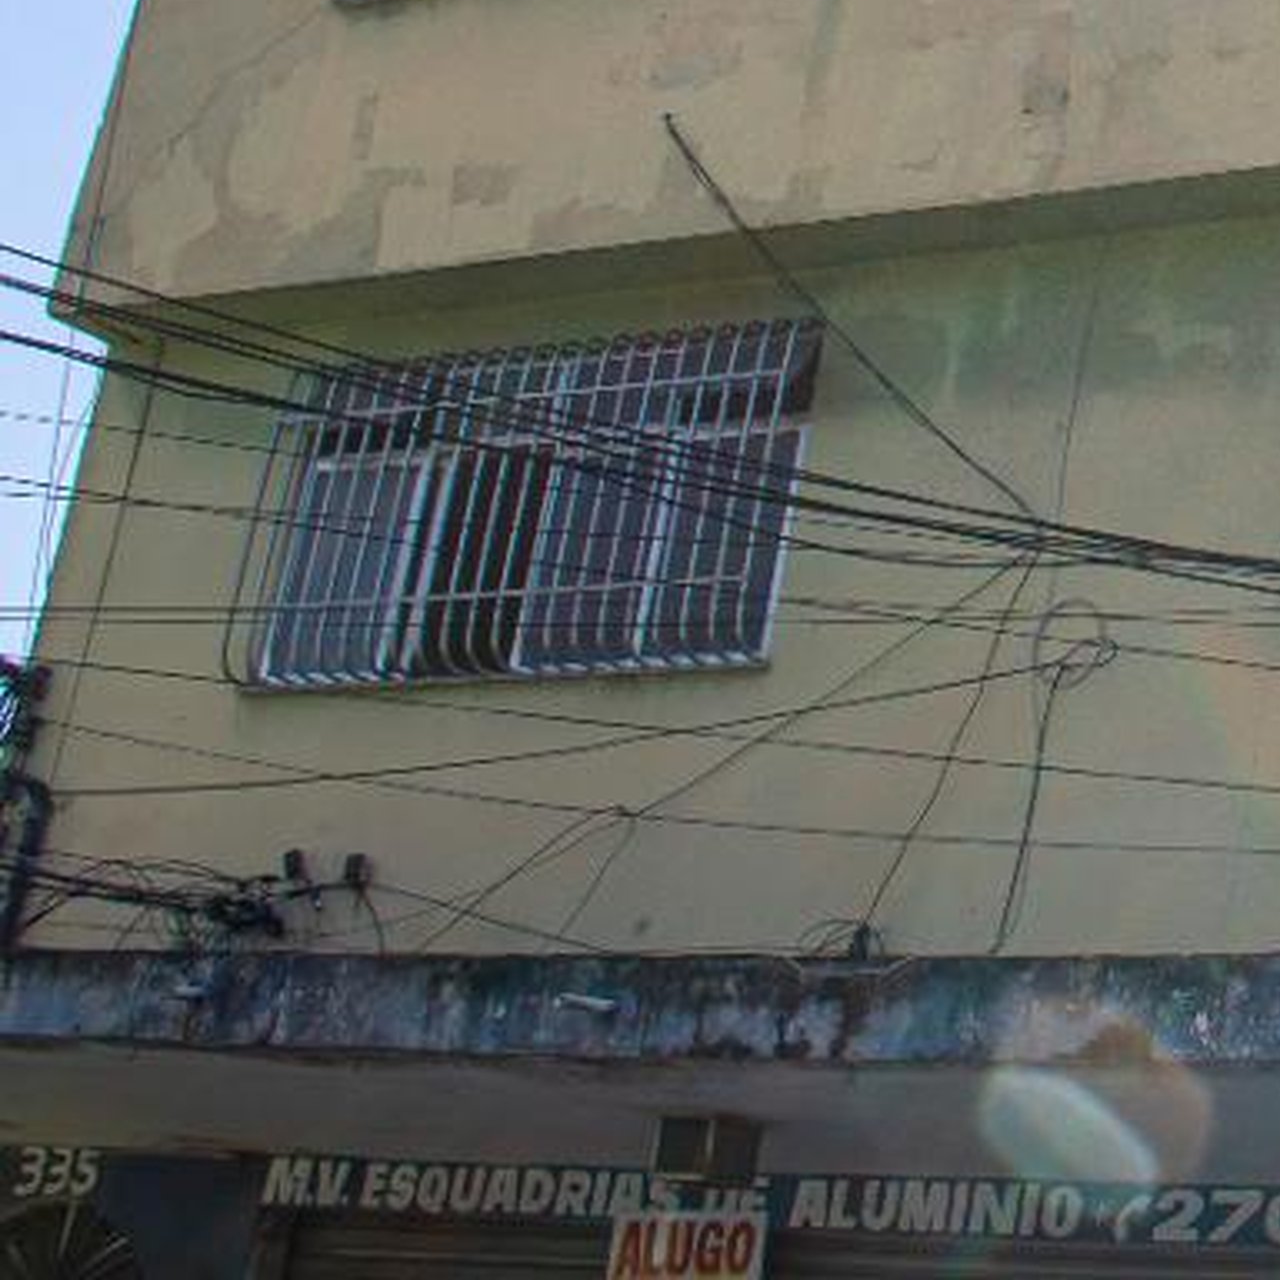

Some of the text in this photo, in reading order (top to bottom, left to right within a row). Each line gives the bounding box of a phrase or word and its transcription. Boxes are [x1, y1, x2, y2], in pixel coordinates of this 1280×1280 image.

[13, 1145, 101, 1198] 335
[261, 1156, 350, 1206] M.V.
[358, 1162, 682, 1218] ESQUADRIAS
[789, 1178, 1084, 1238] ALUMINIO
[613, 1219, 758, 1276] ALUGO
